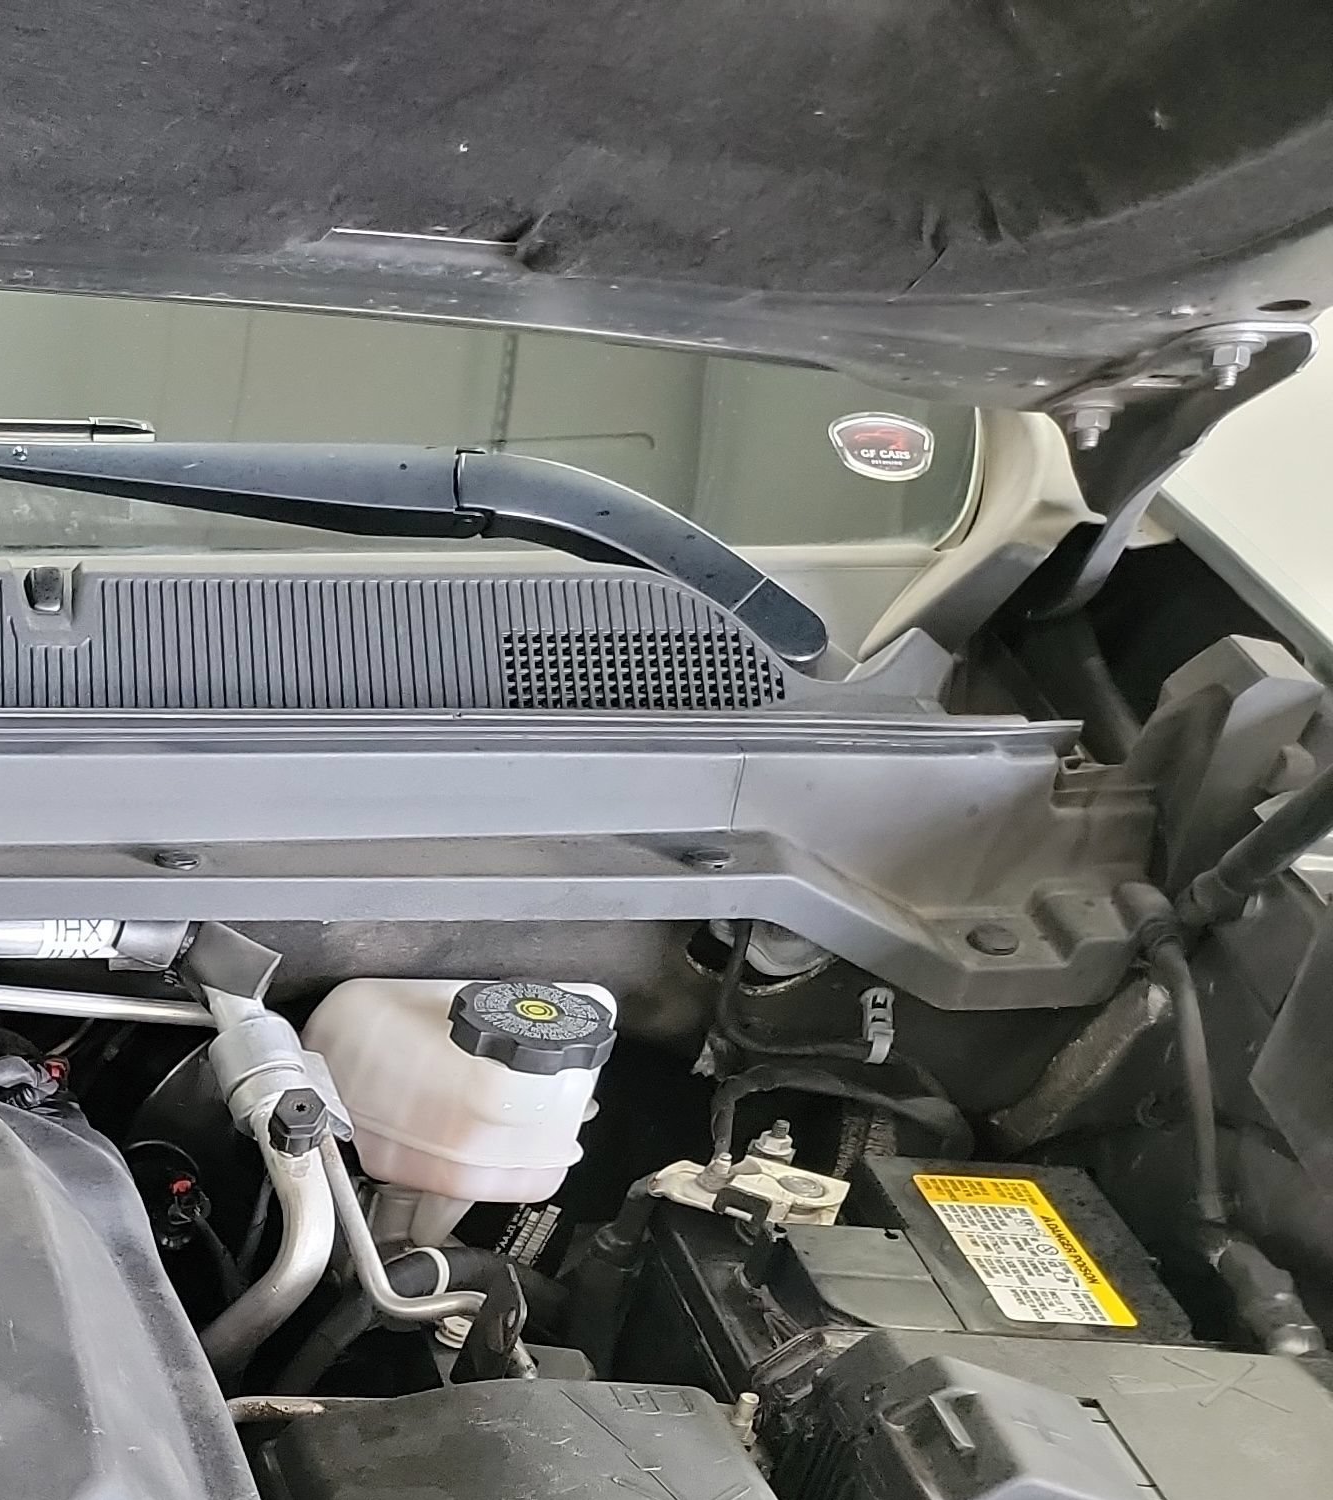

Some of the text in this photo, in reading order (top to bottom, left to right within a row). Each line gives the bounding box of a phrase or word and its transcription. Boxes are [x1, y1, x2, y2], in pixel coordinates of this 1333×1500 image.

[879, 450, 911, 460] CARS
[1047, 1223, 1100, 1284] DANGER POISON
